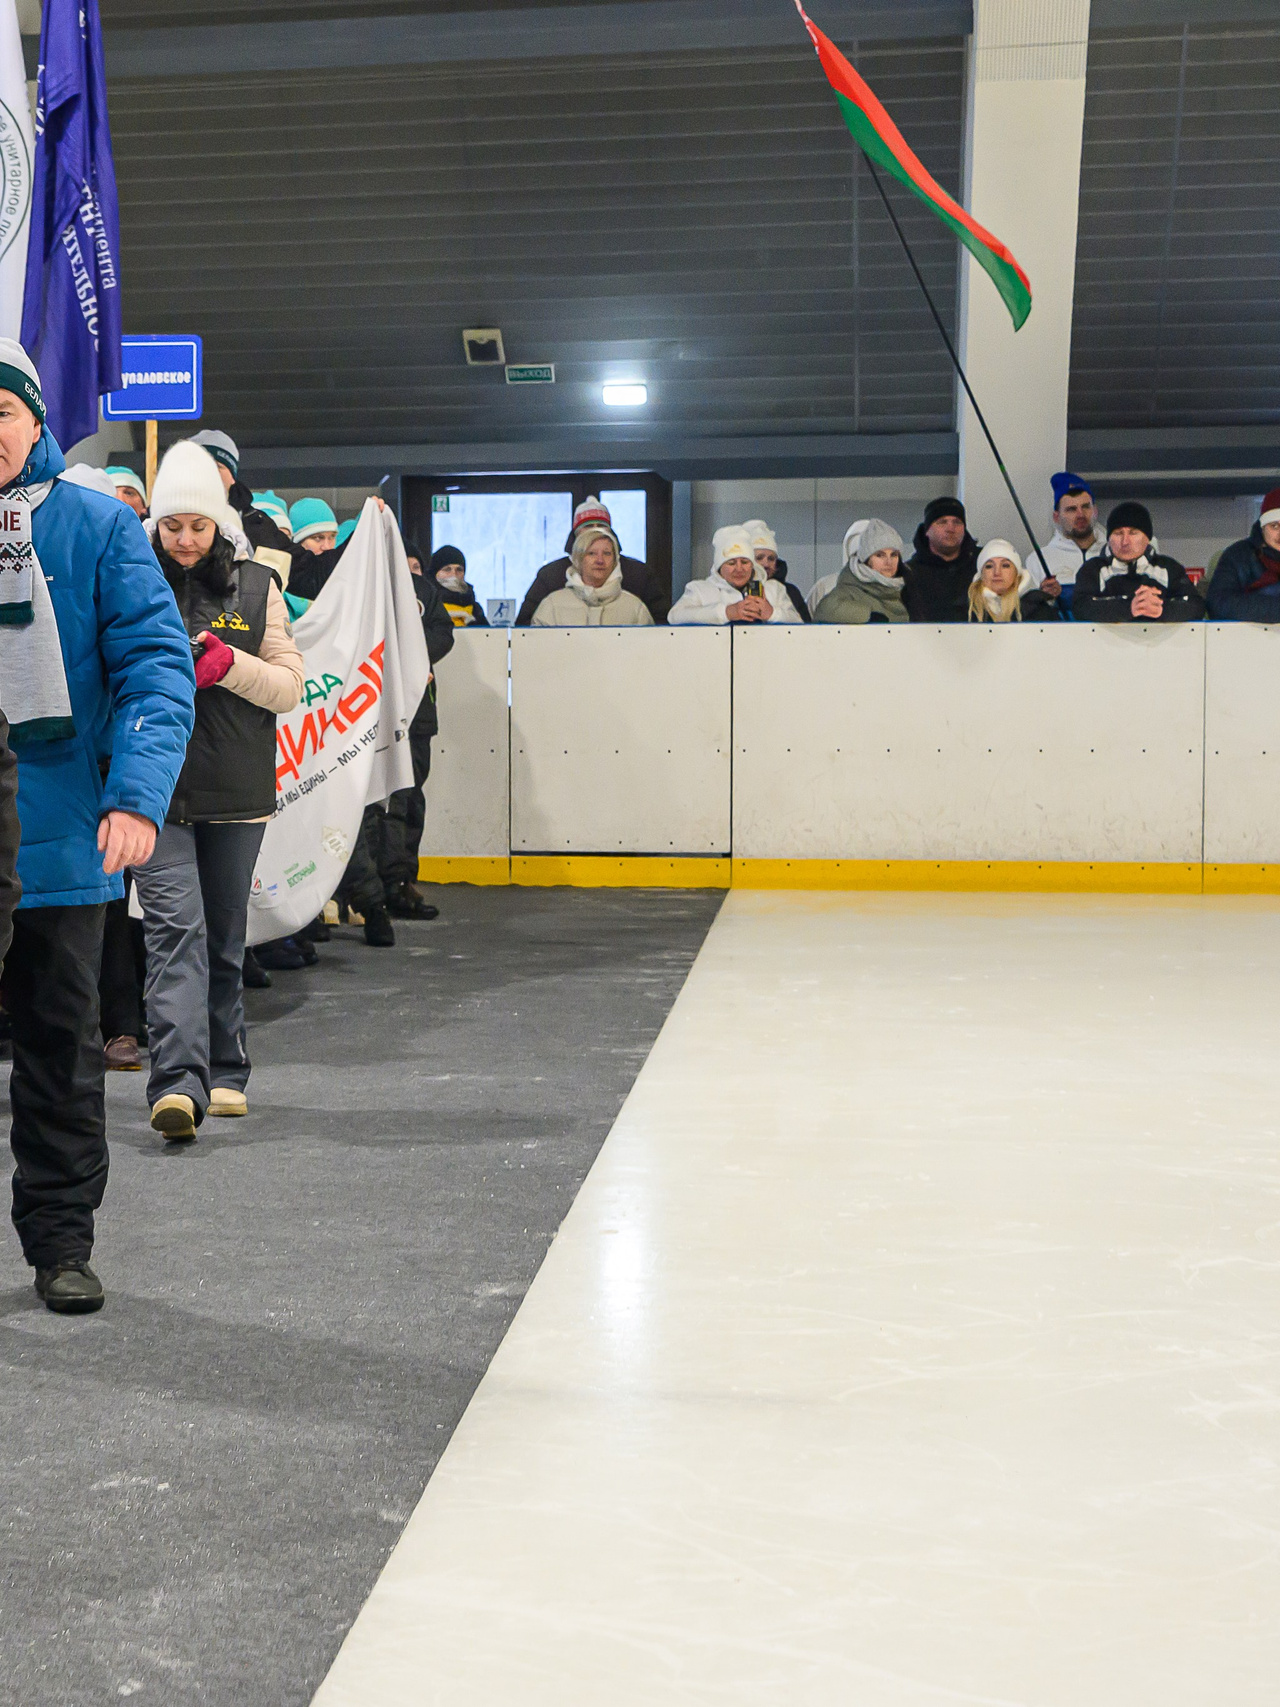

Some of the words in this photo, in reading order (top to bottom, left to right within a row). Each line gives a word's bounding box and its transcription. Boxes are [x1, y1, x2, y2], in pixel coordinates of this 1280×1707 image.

[1, 133, 23, 216] унитарное
[121, 371, 191, 389] упаловское
[300, 673, 344, 707] ДА
[285, 787, 301, 805] МЫ
[298, 769, 328, 795] ЕДИНЫ
[337, 744, 361, 766] МЫ
